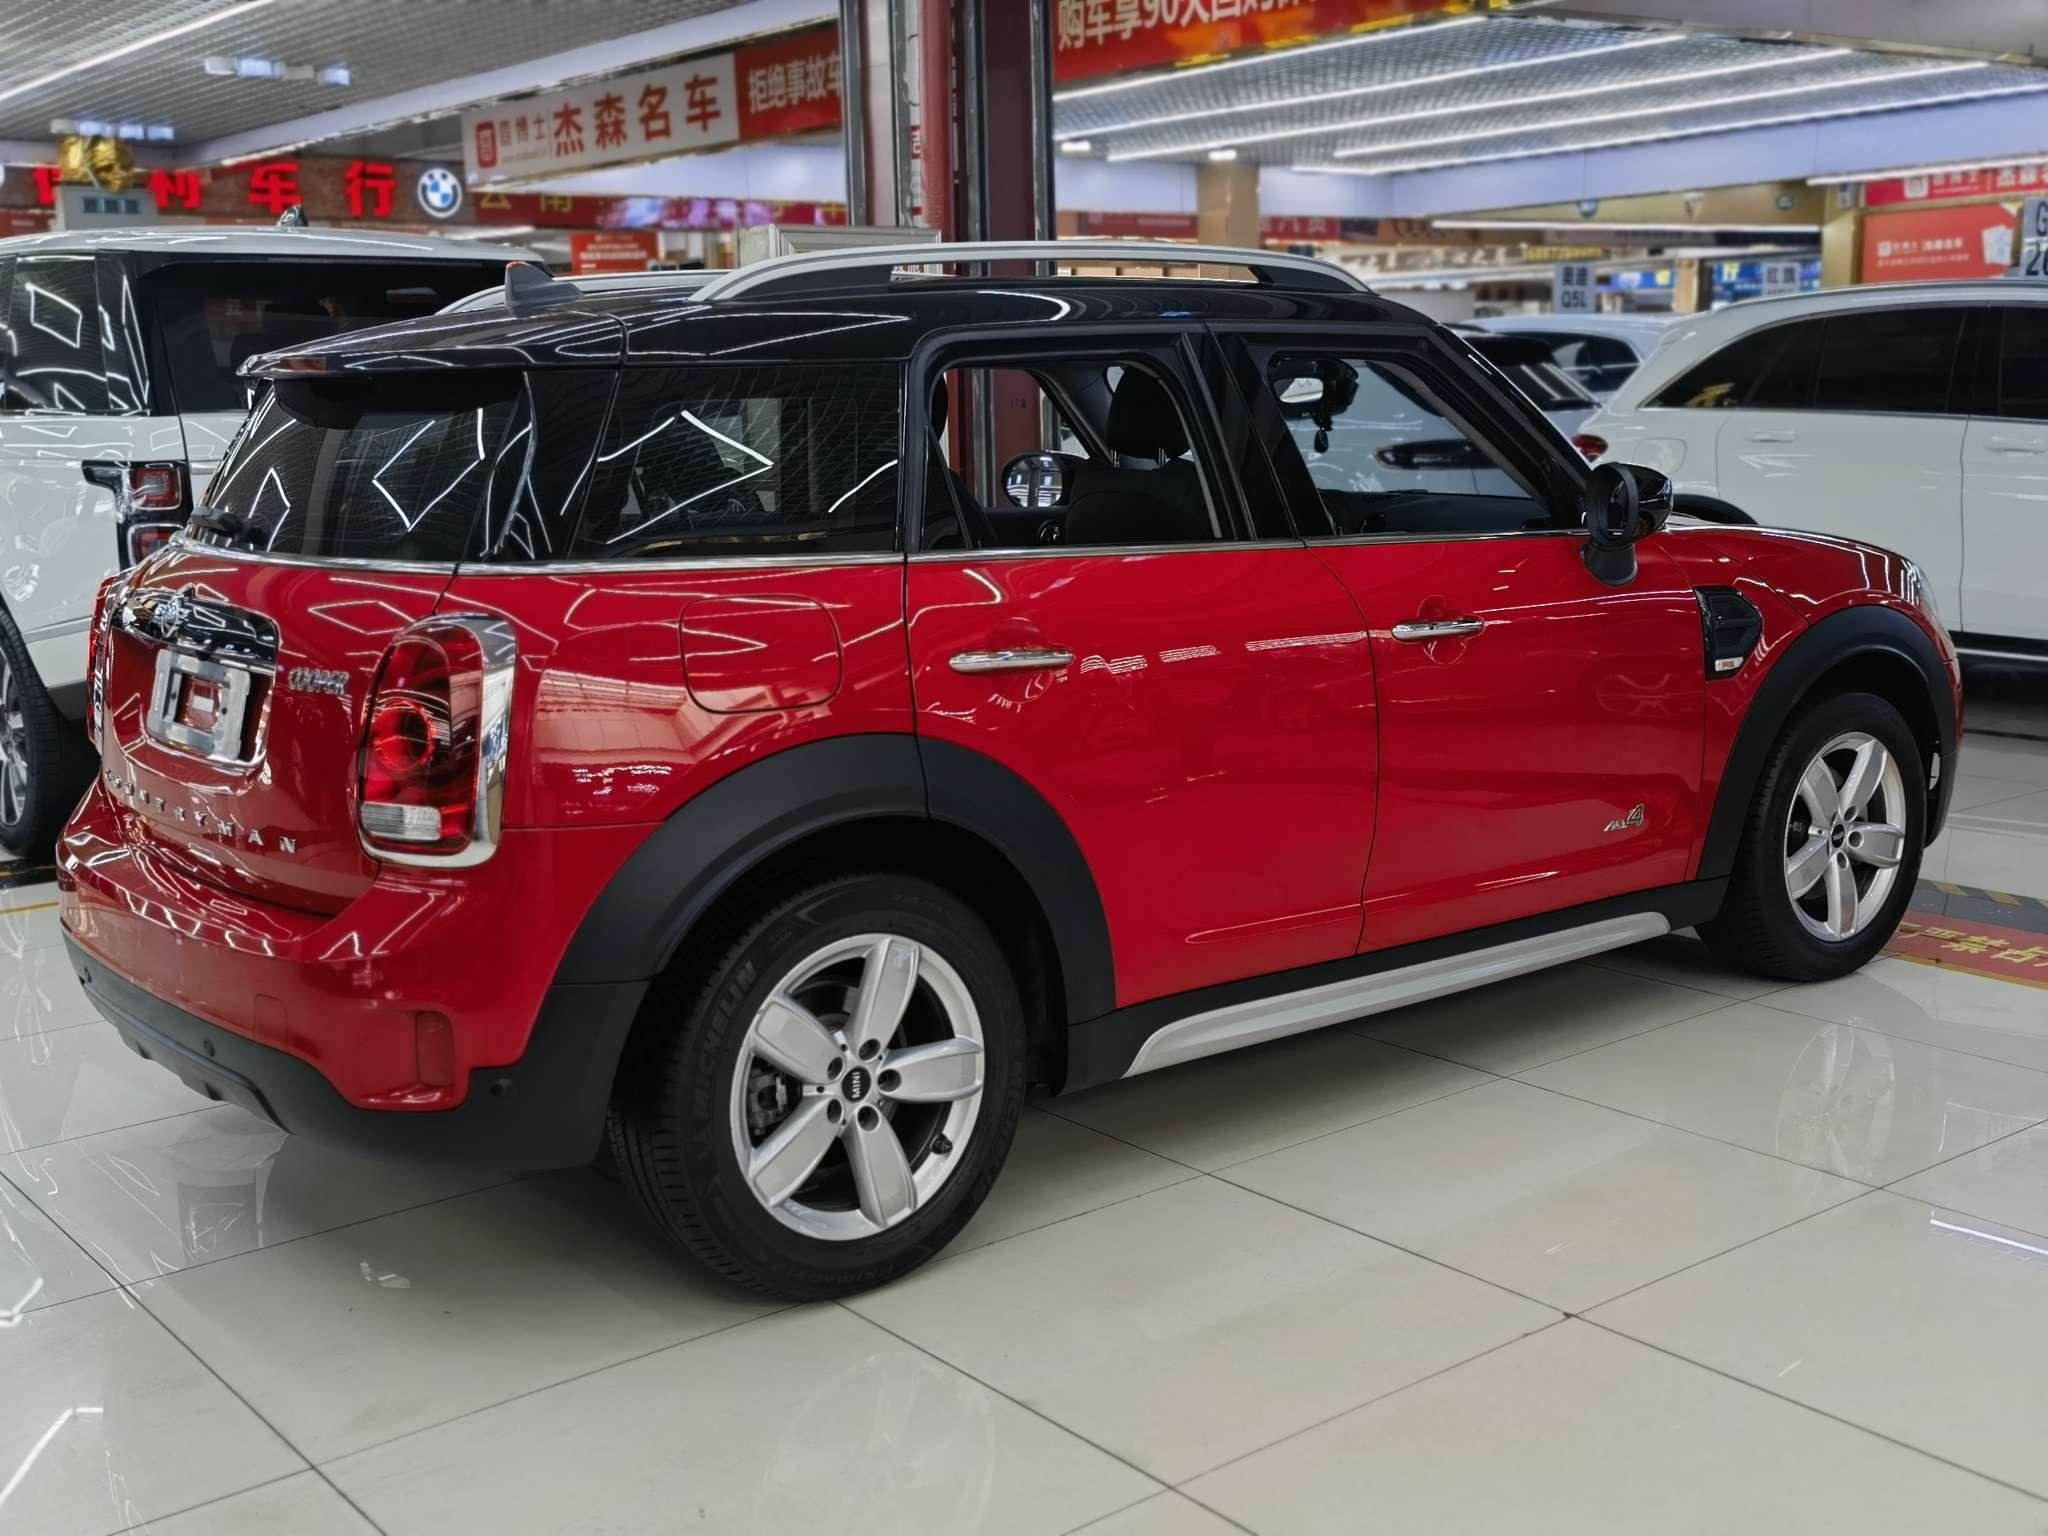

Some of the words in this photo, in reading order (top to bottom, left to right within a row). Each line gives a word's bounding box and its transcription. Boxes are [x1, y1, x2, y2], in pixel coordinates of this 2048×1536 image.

[553, 74, 721, 157] 杰森名车
[288, 667, 350, 697] COOPER
[104, 768, 297, 855] COUNTRYMAN
[851, 1071, 862, 1099] MINI
